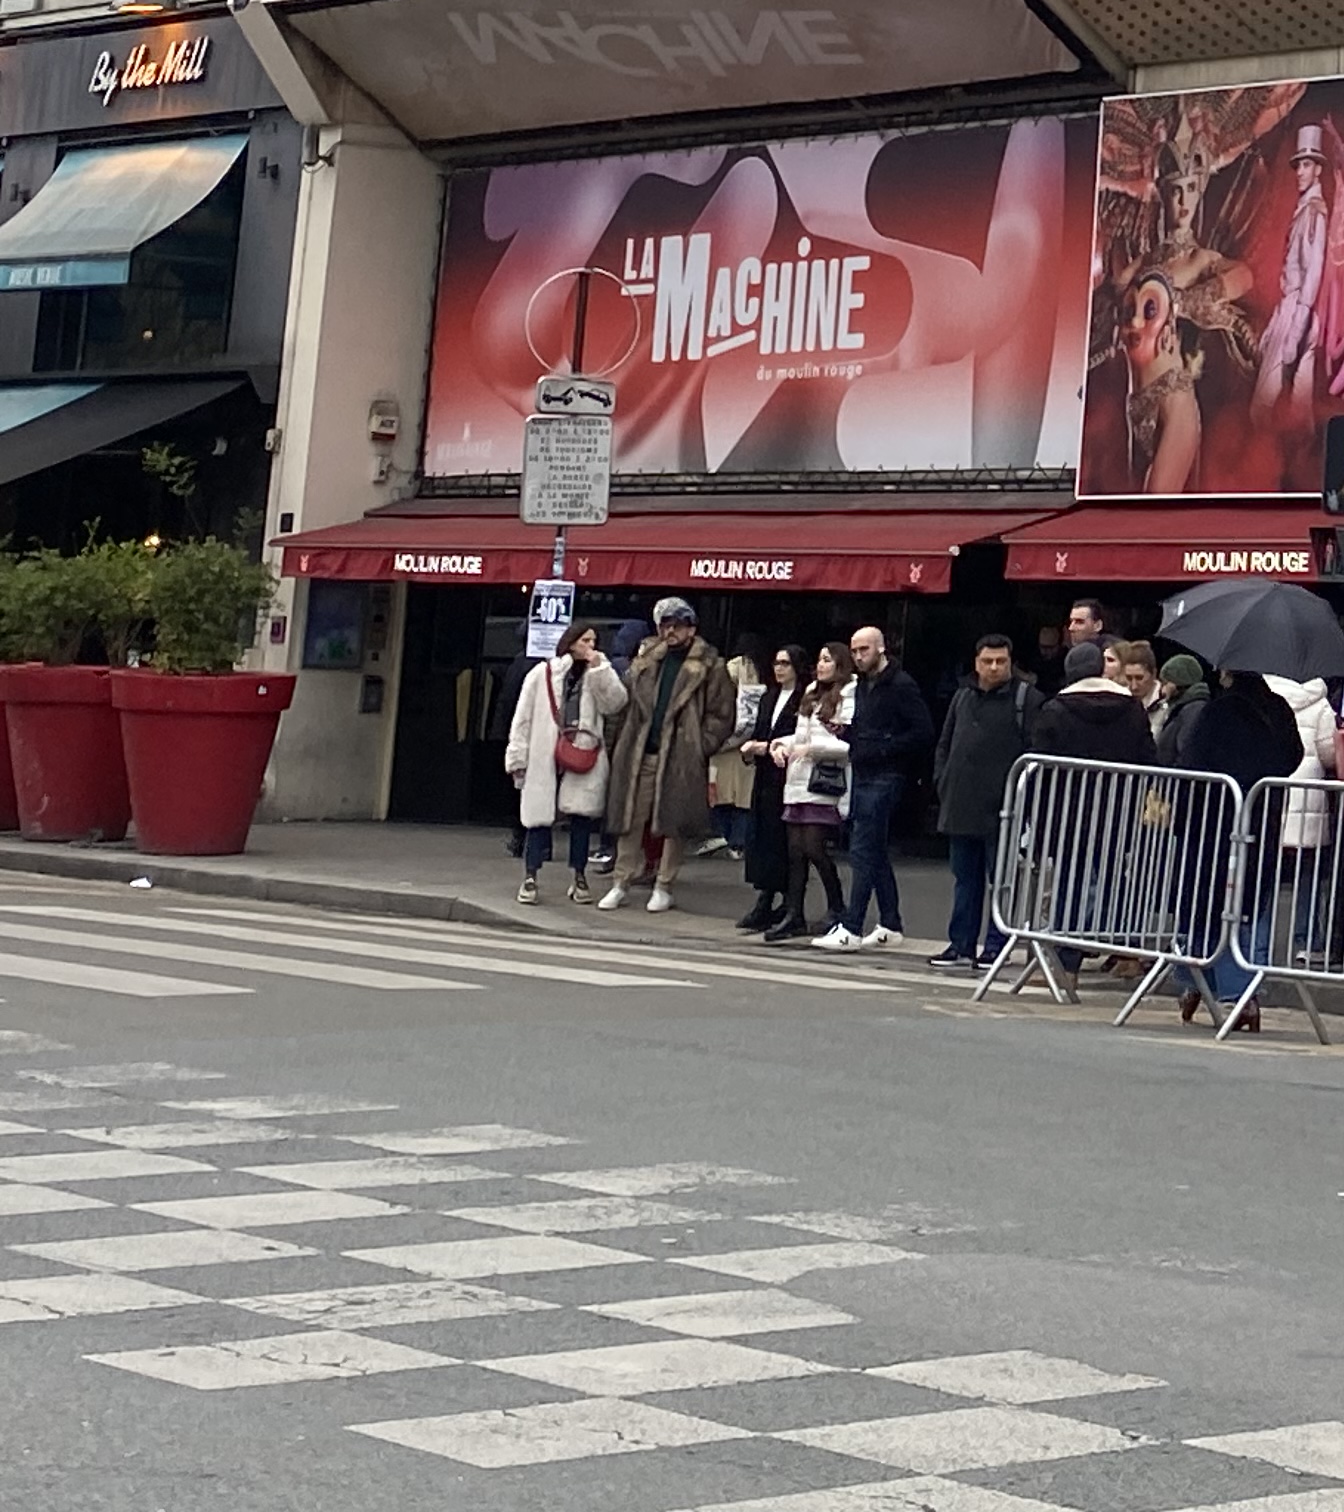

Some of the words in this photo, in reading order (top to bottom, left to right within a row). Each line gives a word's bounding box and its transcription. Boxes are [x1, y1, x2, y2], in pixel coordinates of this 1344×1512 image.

[88, 51, 118, 107] By
[121, 44, 158, 89] the
[156, 36, 208, 85] Mill
[624, 237, 654, 281] LA
[756, 364, 773, 381] du
[776, 363, 820, 380] moulin
[824, 363, 864, 381] rouge
[394, 553, 440, 573] MOULIN
[441, 555, 482, 574] ROUGE
[690, 559, 742, 580] MOULIN
[745, 560, 794, 580] ROUGE
[1183, 550, 1248, 572] MOULIN
[1250, 551, 1310, 573] ROUGE
